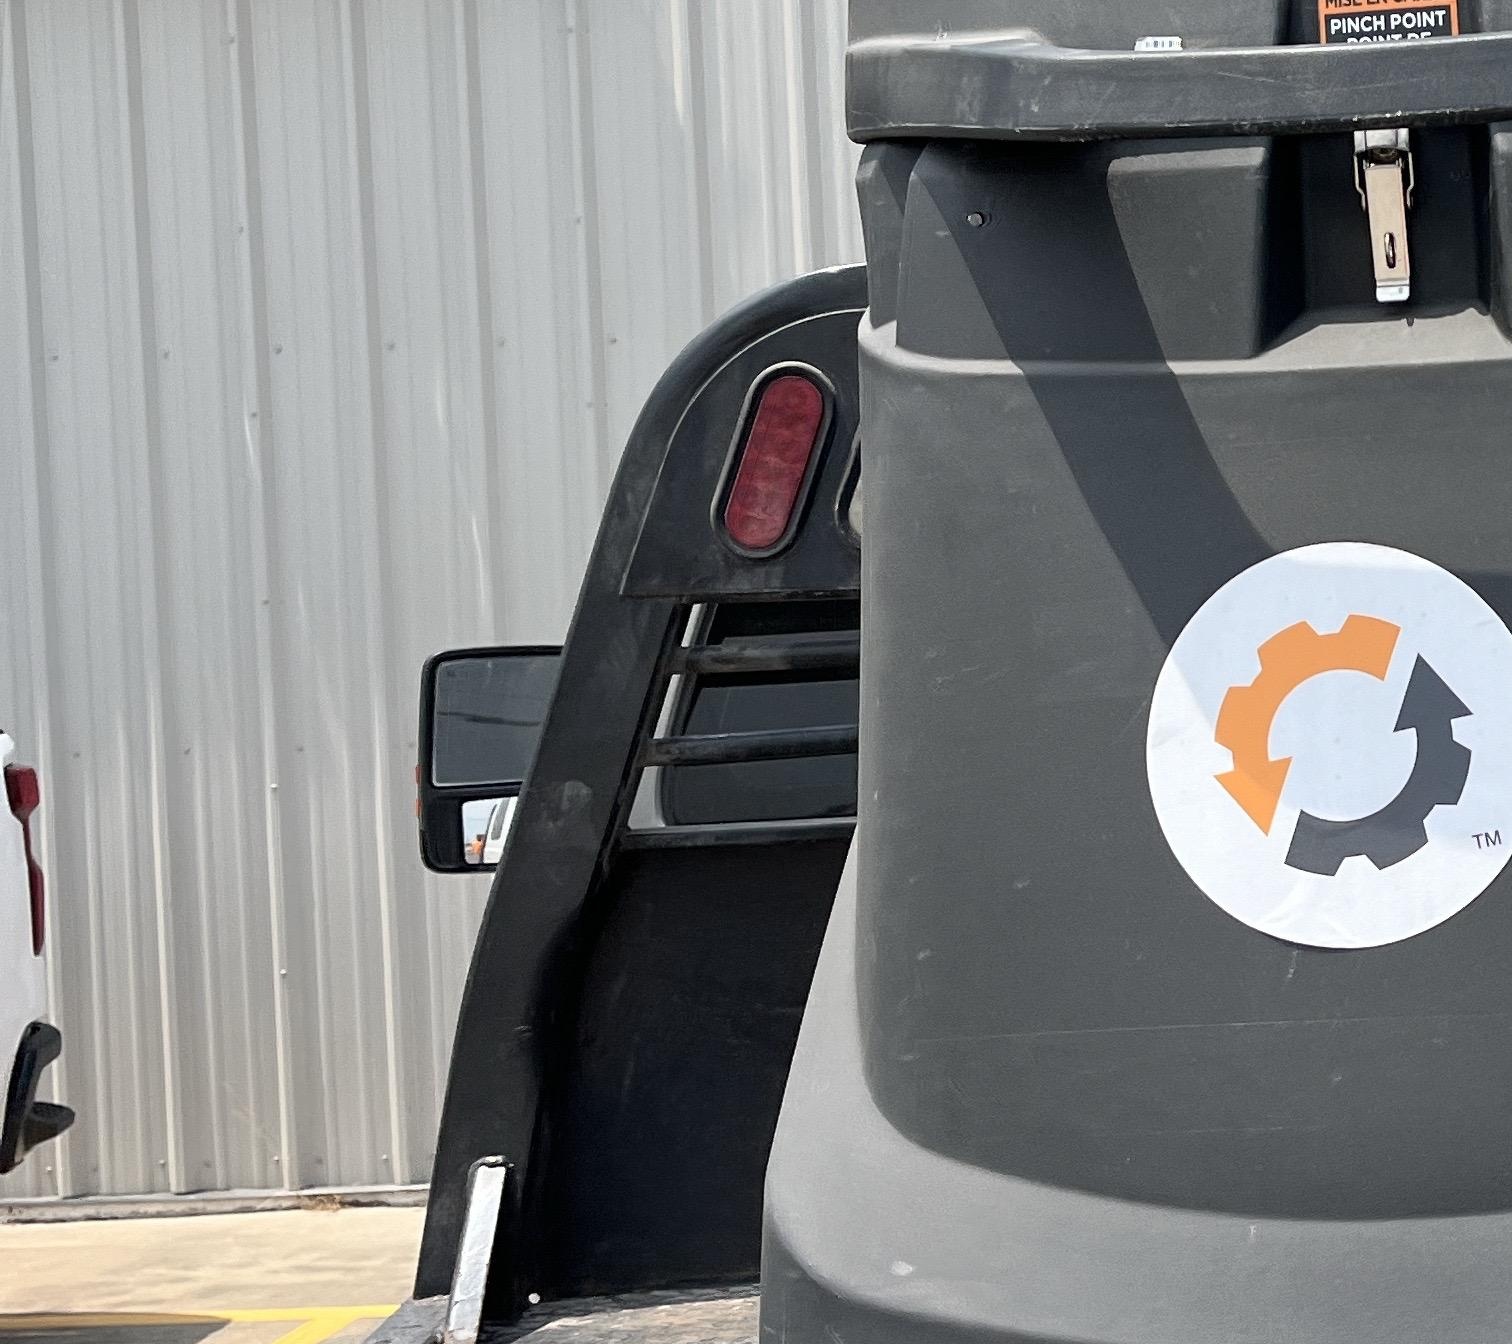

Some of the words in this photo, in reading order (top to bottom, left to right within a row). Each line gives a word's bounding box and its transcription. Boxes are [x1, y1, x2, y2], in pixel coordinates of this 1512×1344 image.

[1330, 14, 1386, 35] PINCH
[1389, 9, 1446, 30] POINT
[1471, 829, 1502, 849] TM
